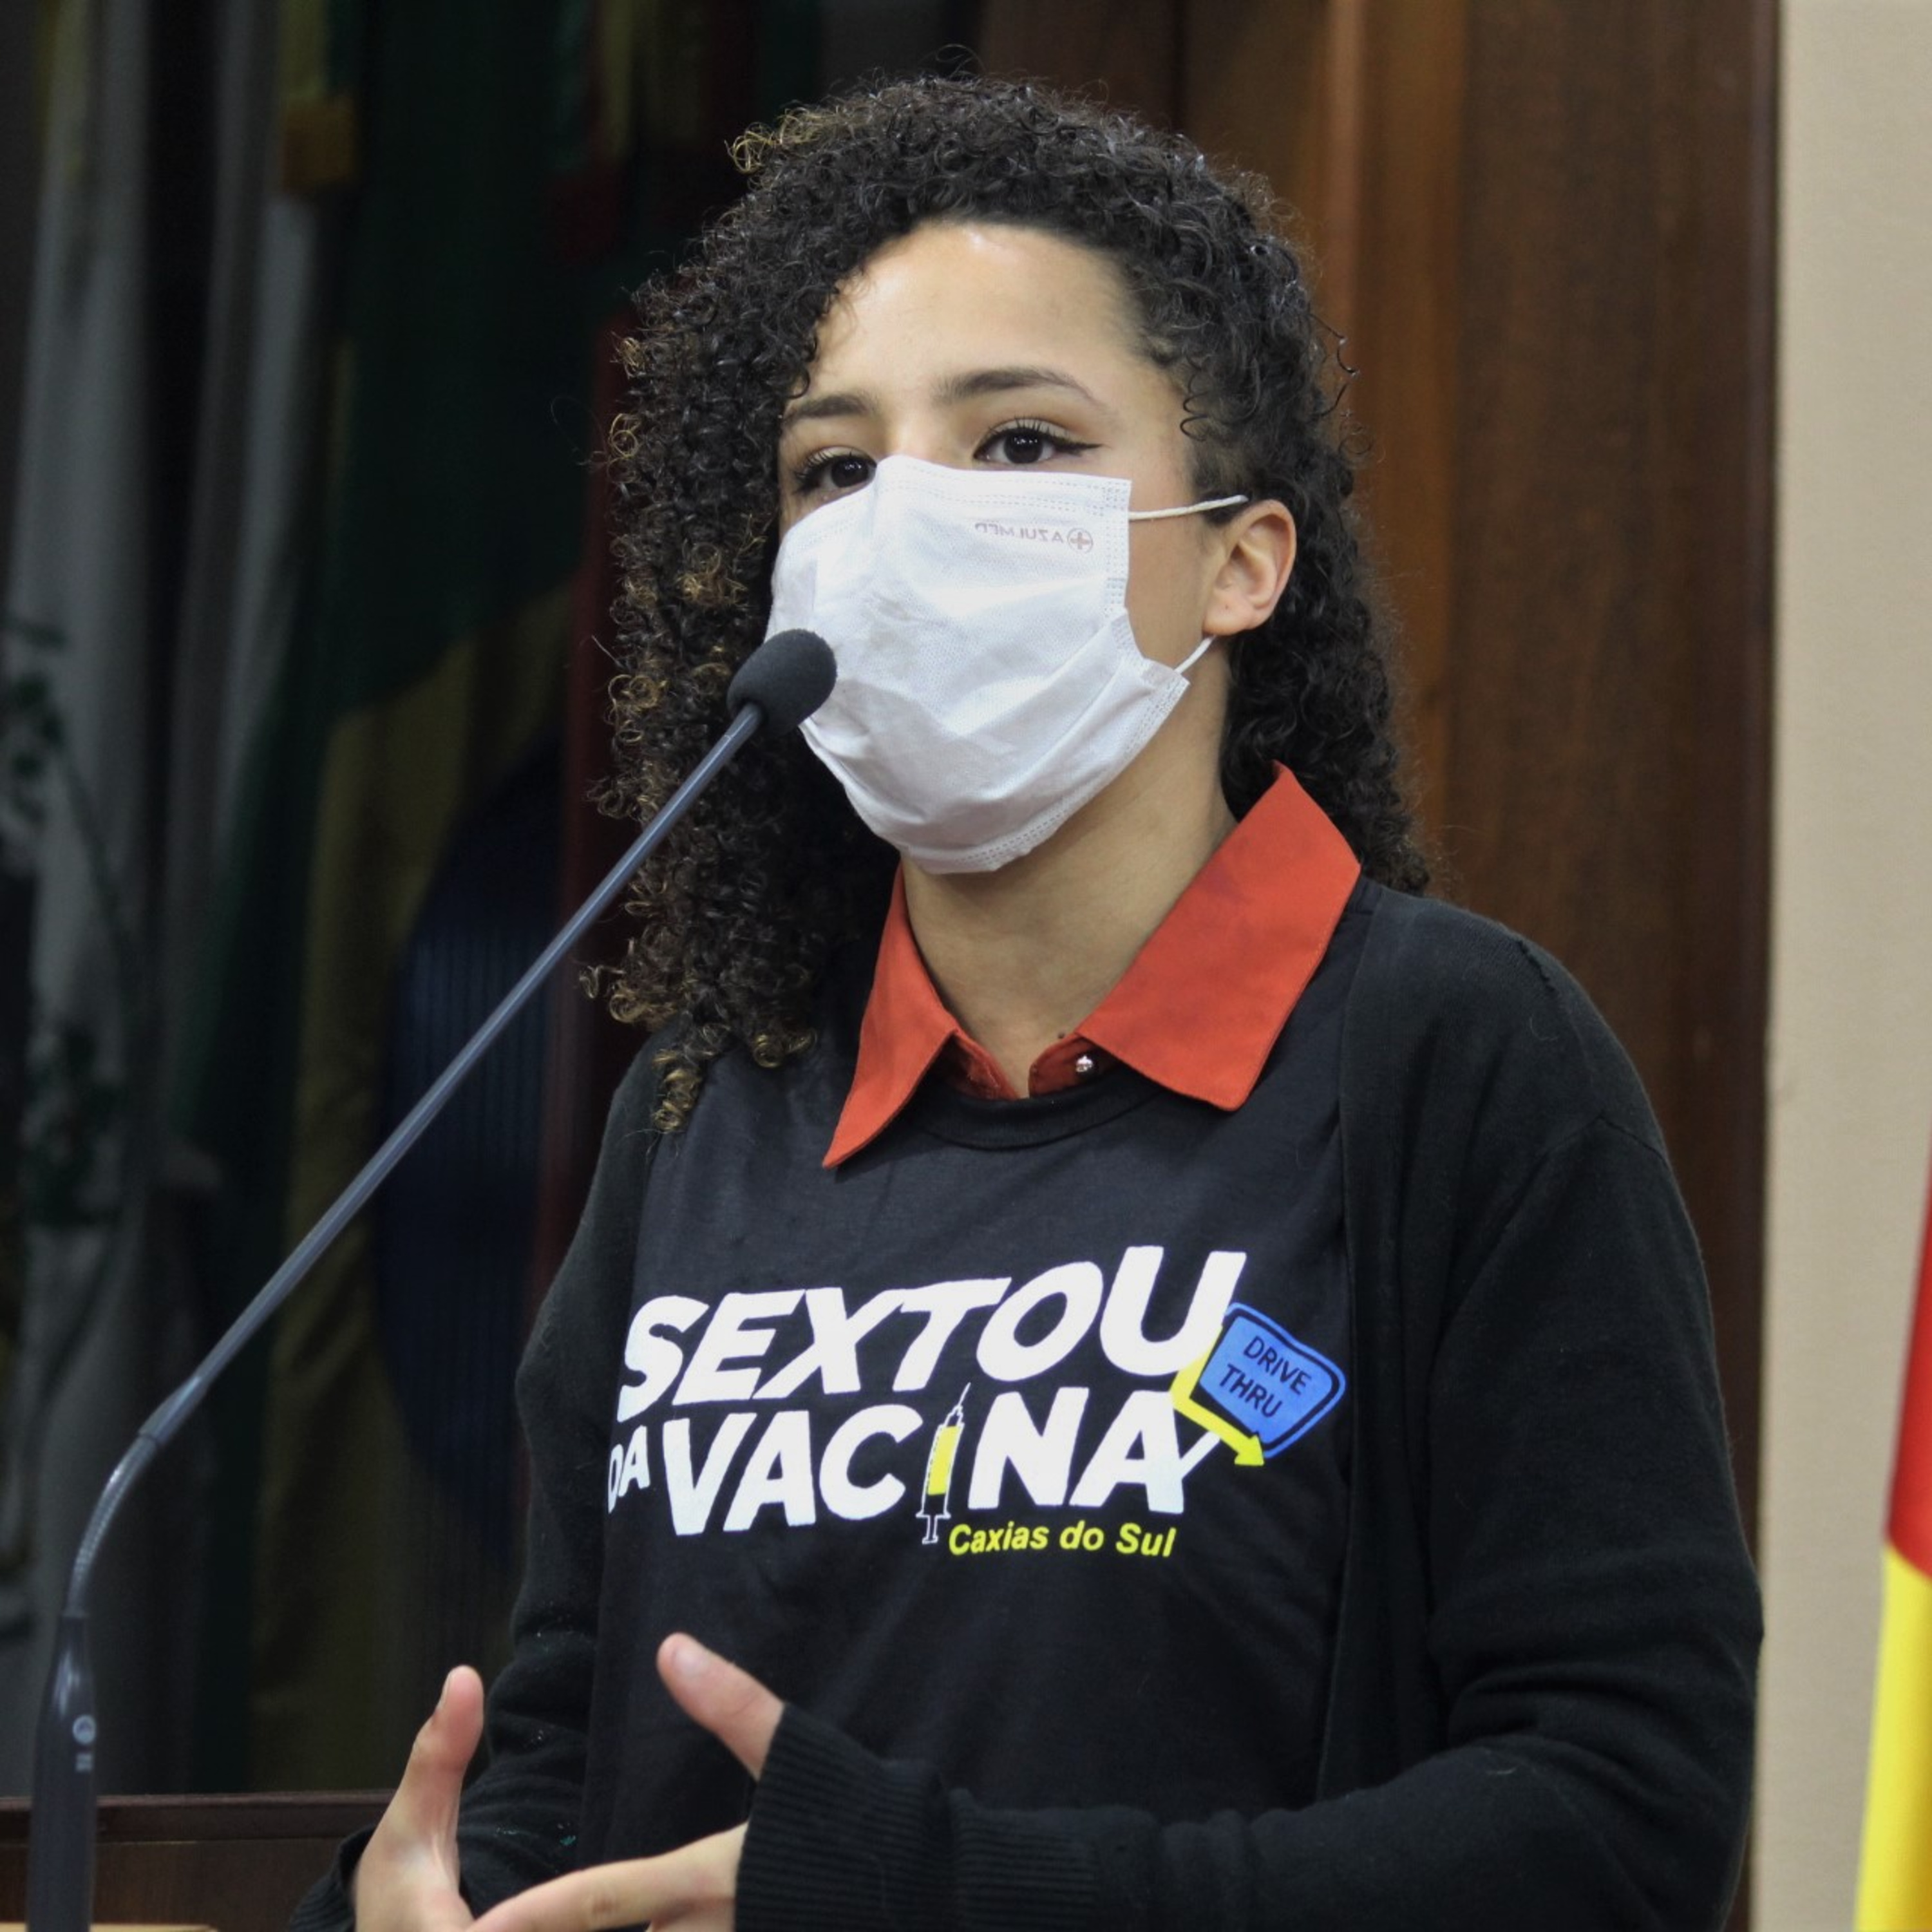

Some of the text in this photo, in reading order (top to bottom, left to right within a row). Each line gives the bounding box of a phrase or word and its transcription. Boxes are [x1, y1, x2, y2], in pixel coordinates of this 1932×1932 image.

[616, 1245, 1247, 1423] SEXTOU
[1219, 1363, 1283, 1418] THRU
[1243, 1335, 1312, 1396] DRIVE
[608, 1425, 651, 1514] DA
[947, 1520, 1178, 1558] Caxias do Sul
